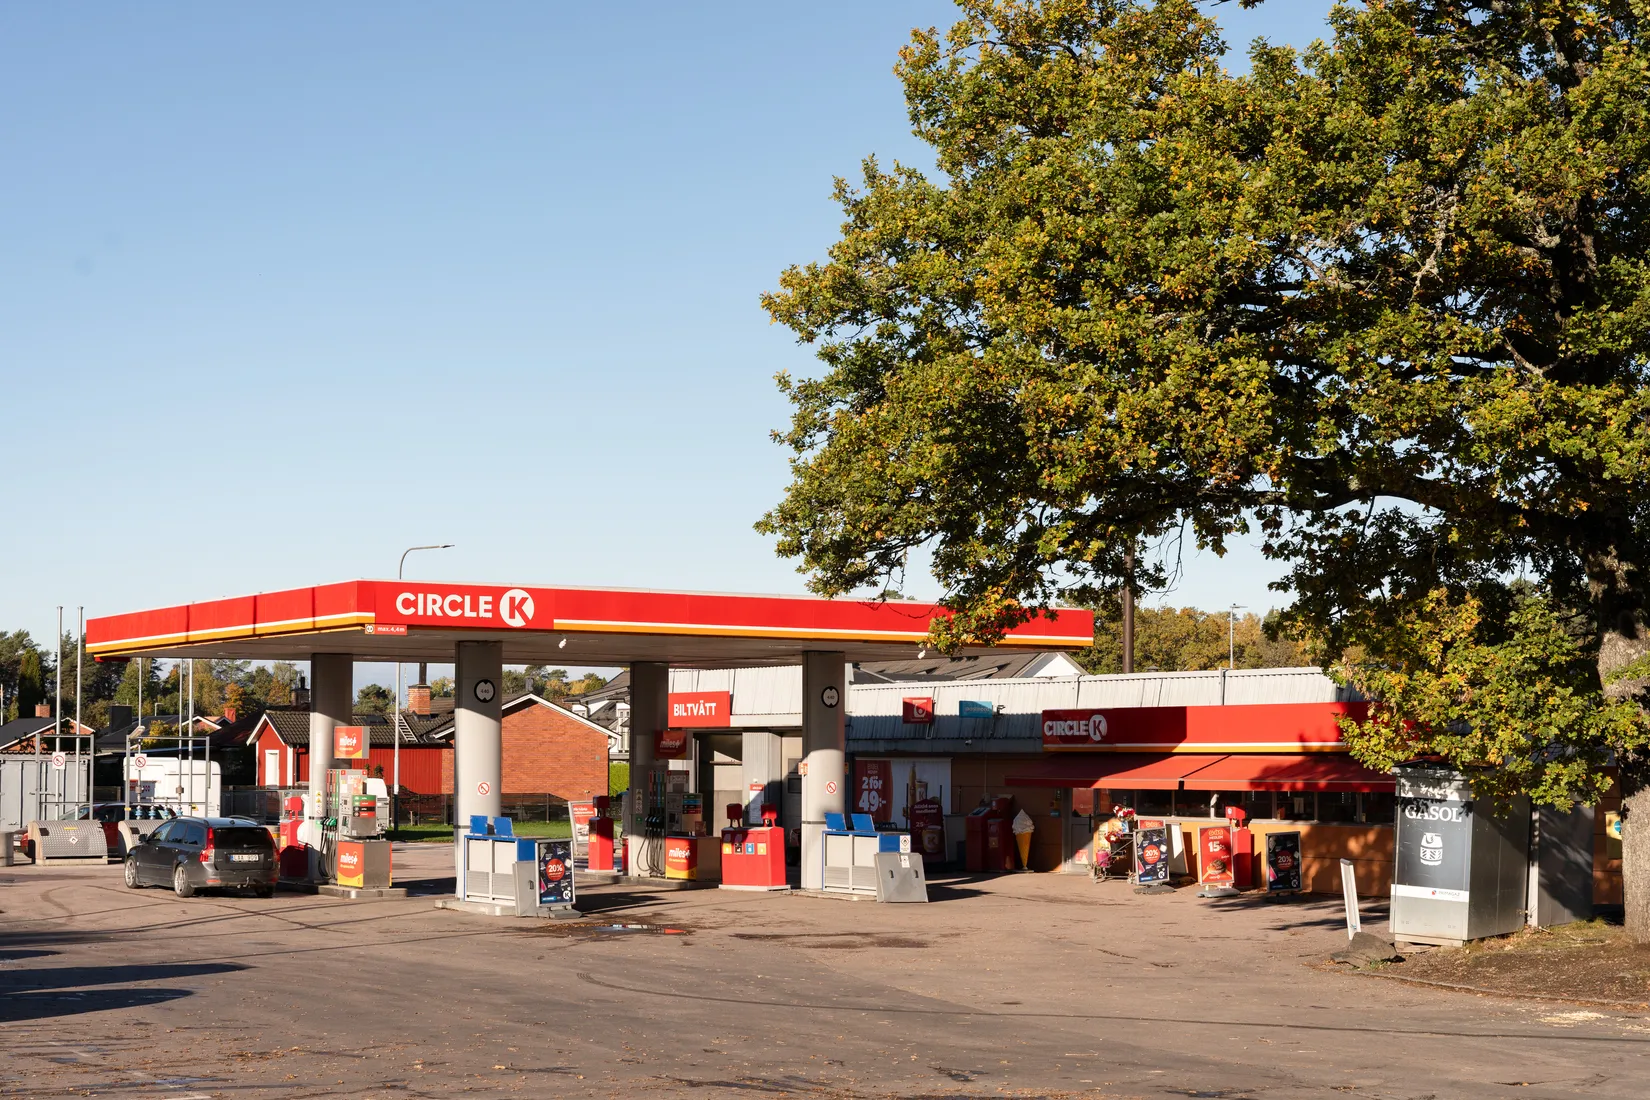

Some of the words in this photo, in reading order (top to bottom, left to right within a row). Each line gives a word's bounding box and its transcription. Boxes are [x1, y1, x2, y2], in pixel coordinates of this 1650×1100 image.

[396, 592, 493, 618] CIRCLE
[504, 591, 534, 626] K
[673, 700, 717, 716] BILTVÄTT
[1043, 720, 1089, 737] CIRCLE
[1090, 715, 1107, 740] K
[862, 776, 869, 789] 2
[869, 776, 883, 789] för
[858, 790, 886, 812] 49:-
[1405, 804, 1462, 823] GASOL
[1145, 849, 1158, 857] 20%
[1278, 855, 1292, 863] 20%
[548, 864, 563, 872] 20%
